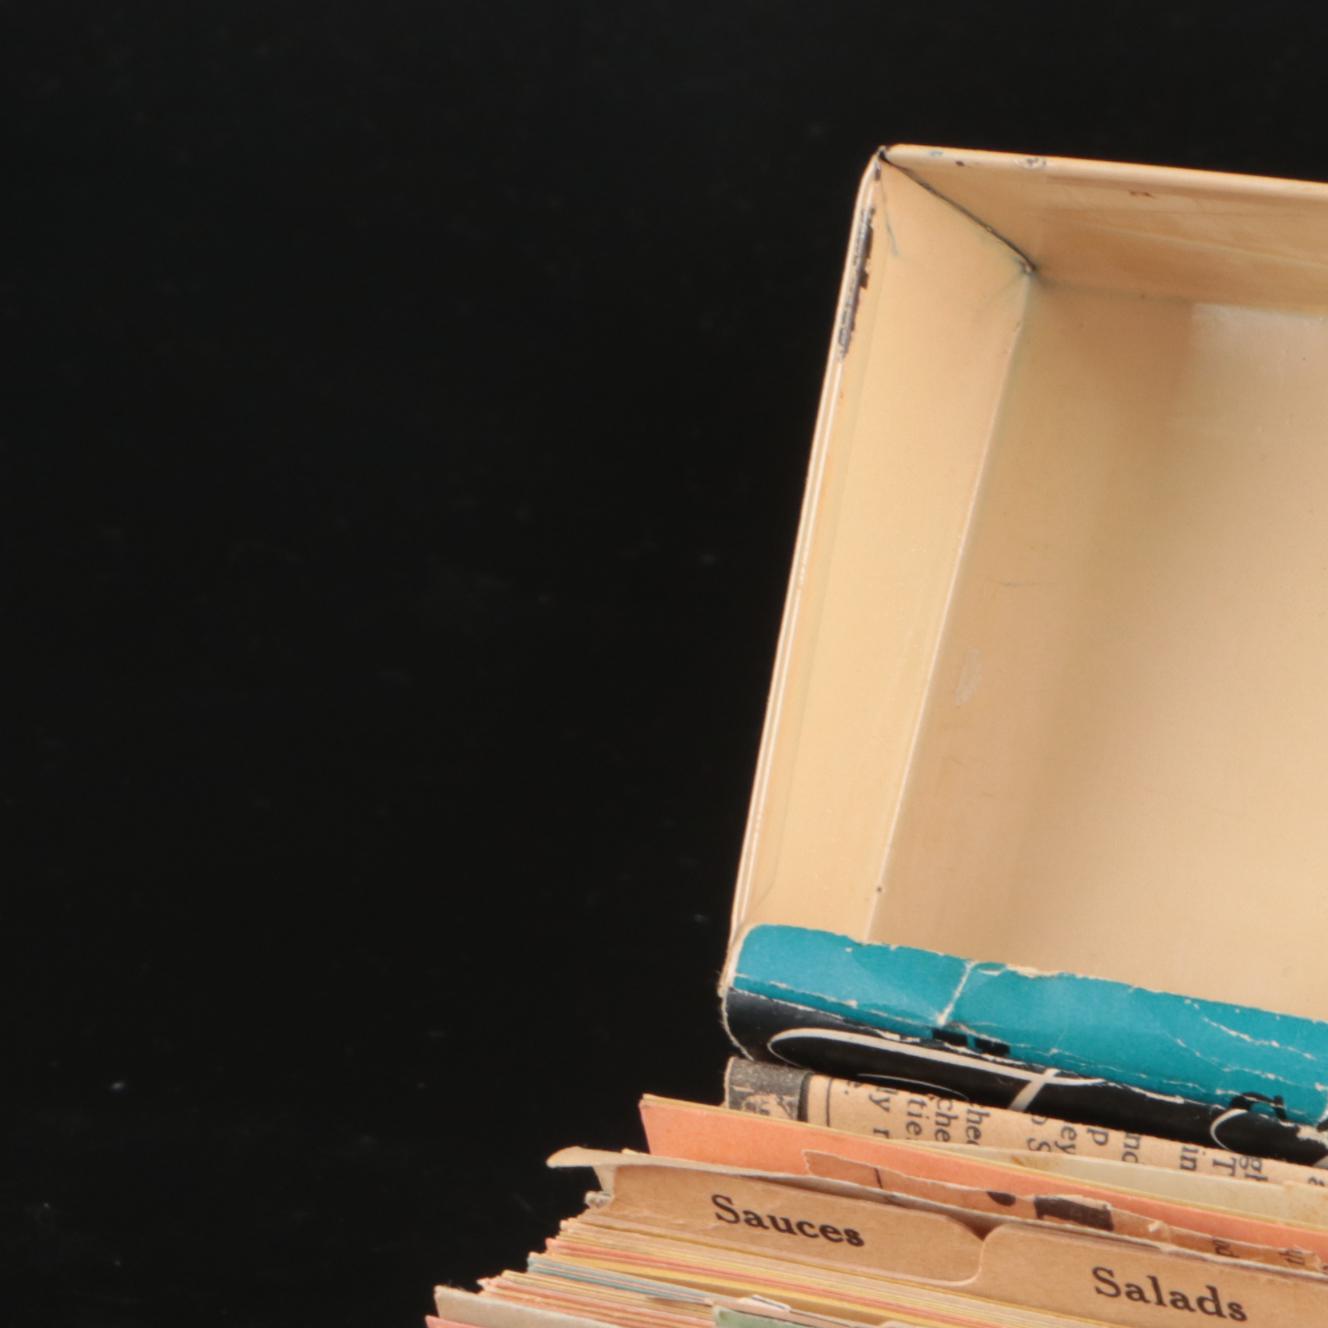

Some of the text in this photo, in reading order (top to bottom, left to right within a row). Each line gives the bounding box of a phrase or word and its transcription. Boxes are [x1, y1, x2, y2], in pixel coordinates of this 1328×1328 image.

[905, 1097, 930, 1140] tie
[711, 1194, 865, 1247] Sauces
[1092, 1265, 1248, 1322] Salads
